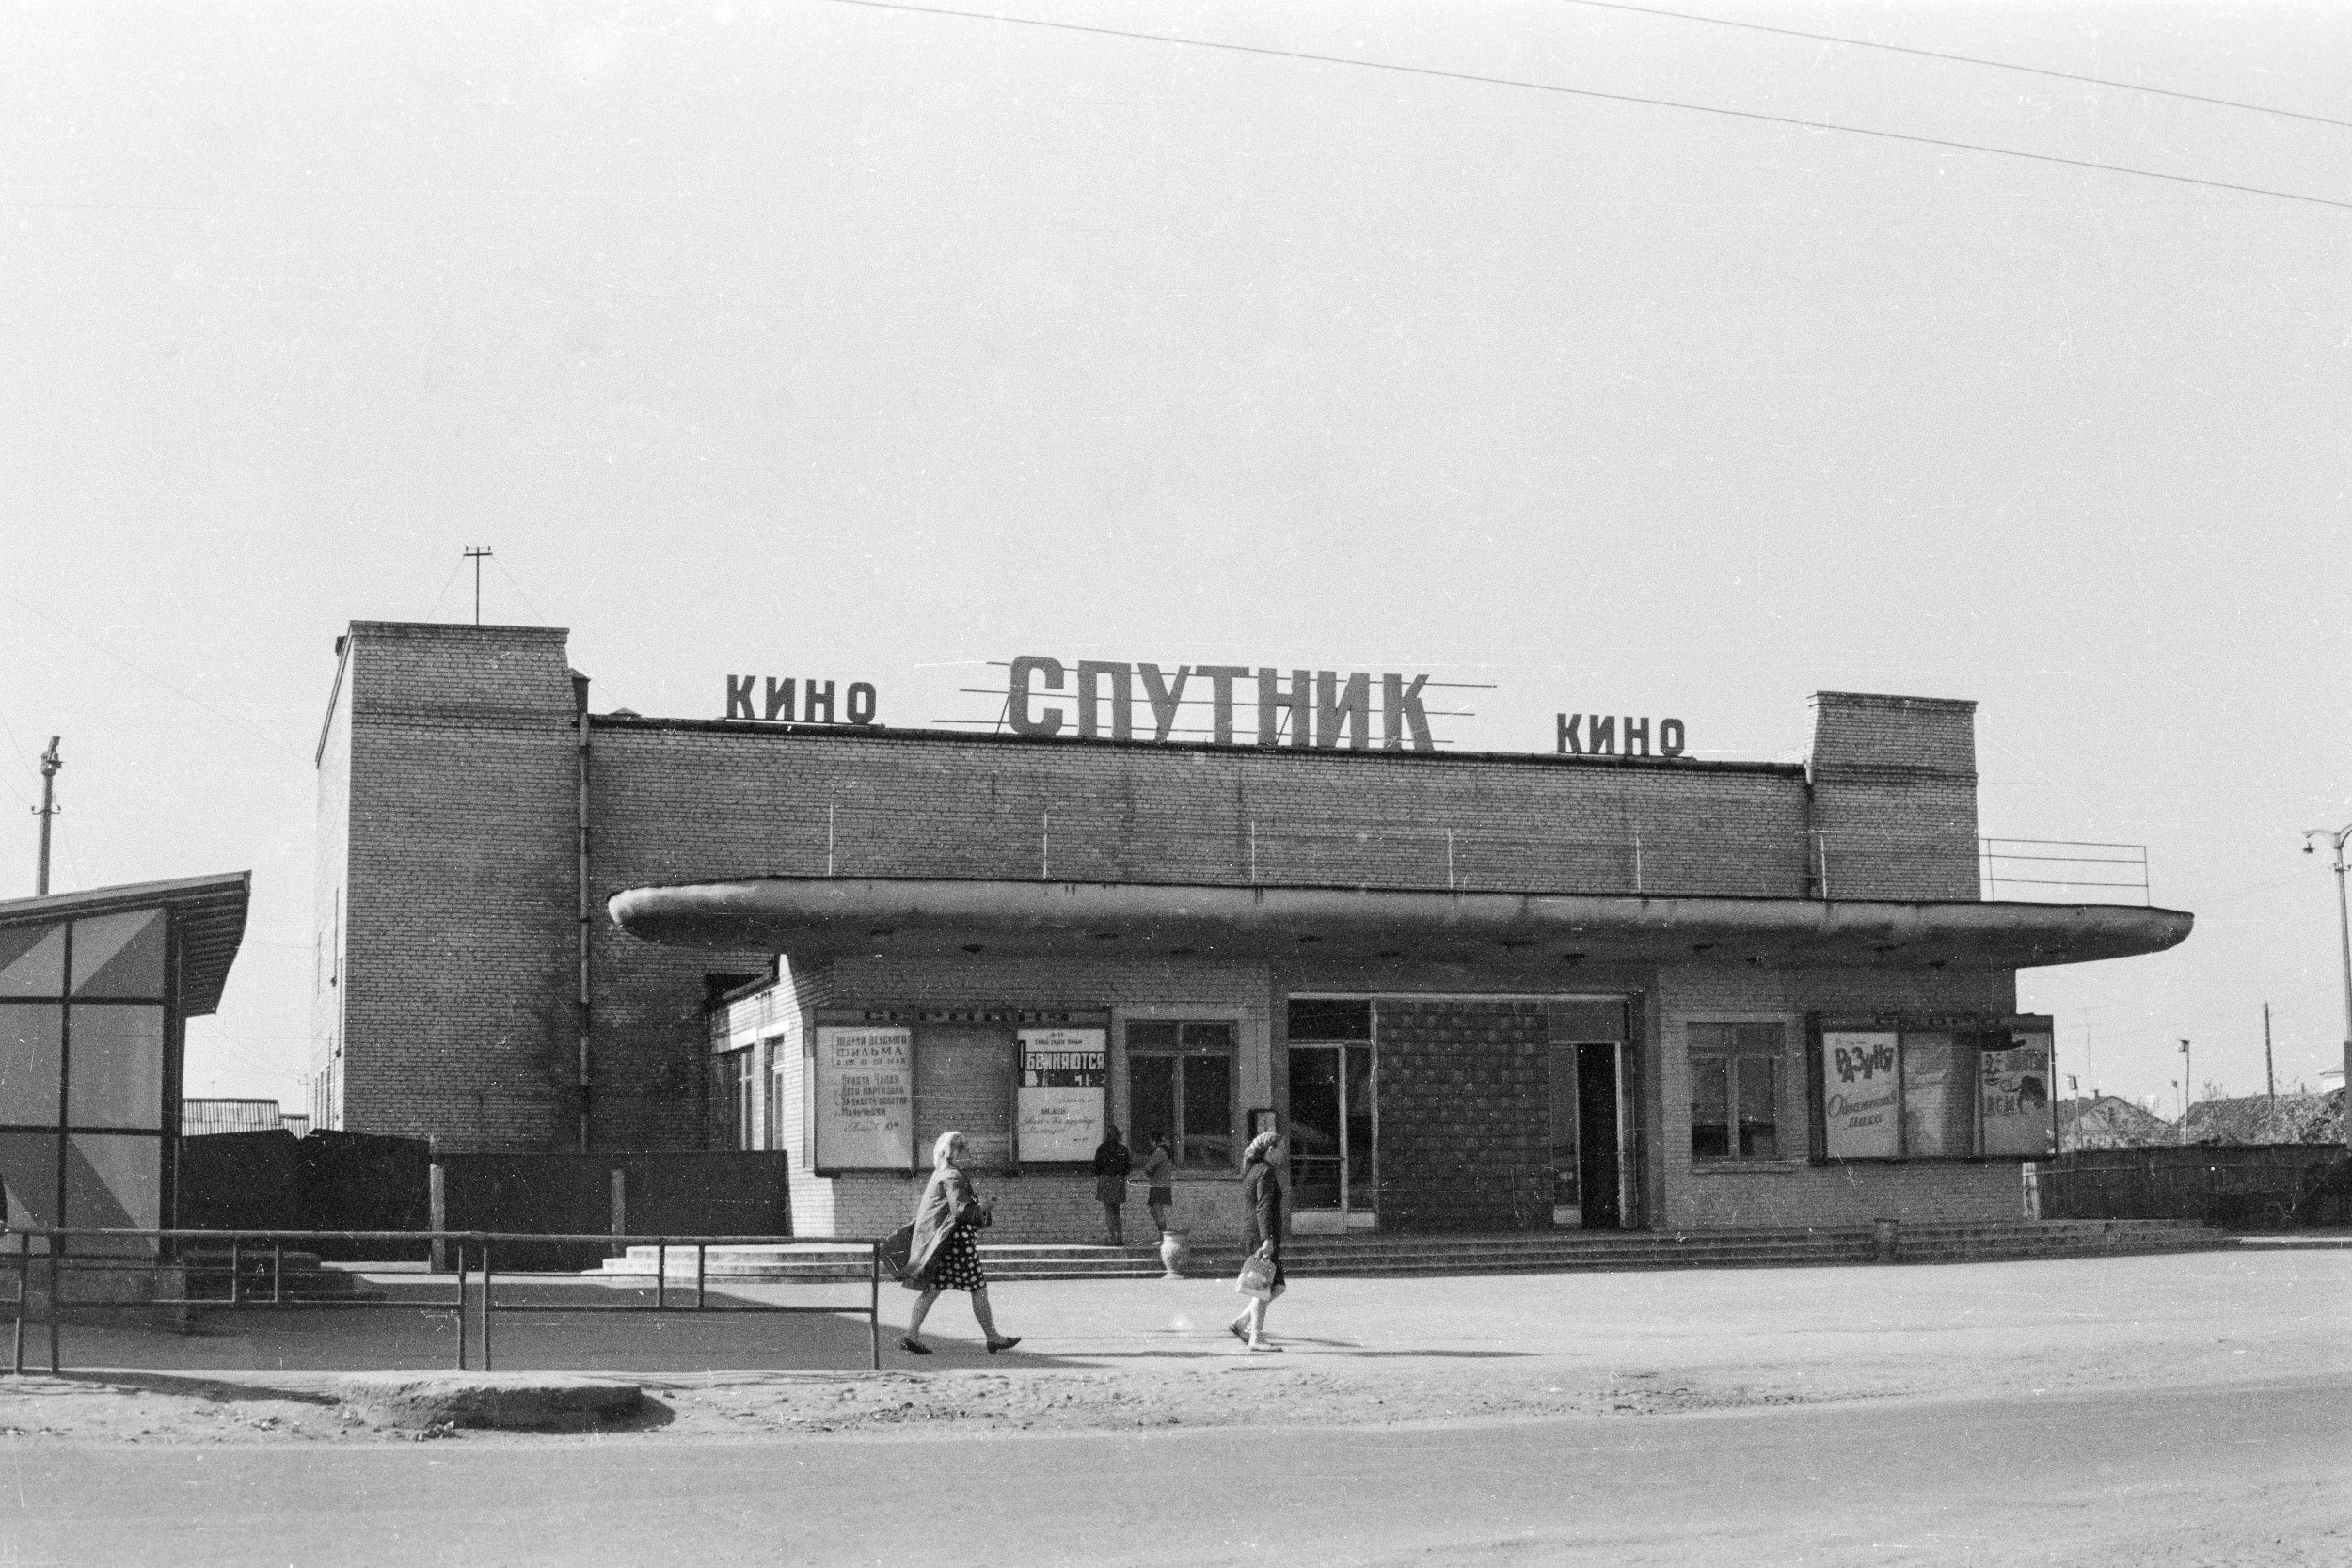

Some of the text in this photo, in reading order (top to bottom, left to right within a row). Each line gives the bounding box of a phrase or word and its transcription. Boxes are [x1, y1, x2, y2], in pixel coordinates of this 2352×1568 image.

[726, 673, 877, 726] КИНО
[1009, 655, 1436, 751] СПУТНИК
[1557, 712, 1686, 757] КИНО
[836, 1046, 903, 1057] ФИЛЬМА
[1835, 1043, 1894, 1083] РАЗИНЯ
